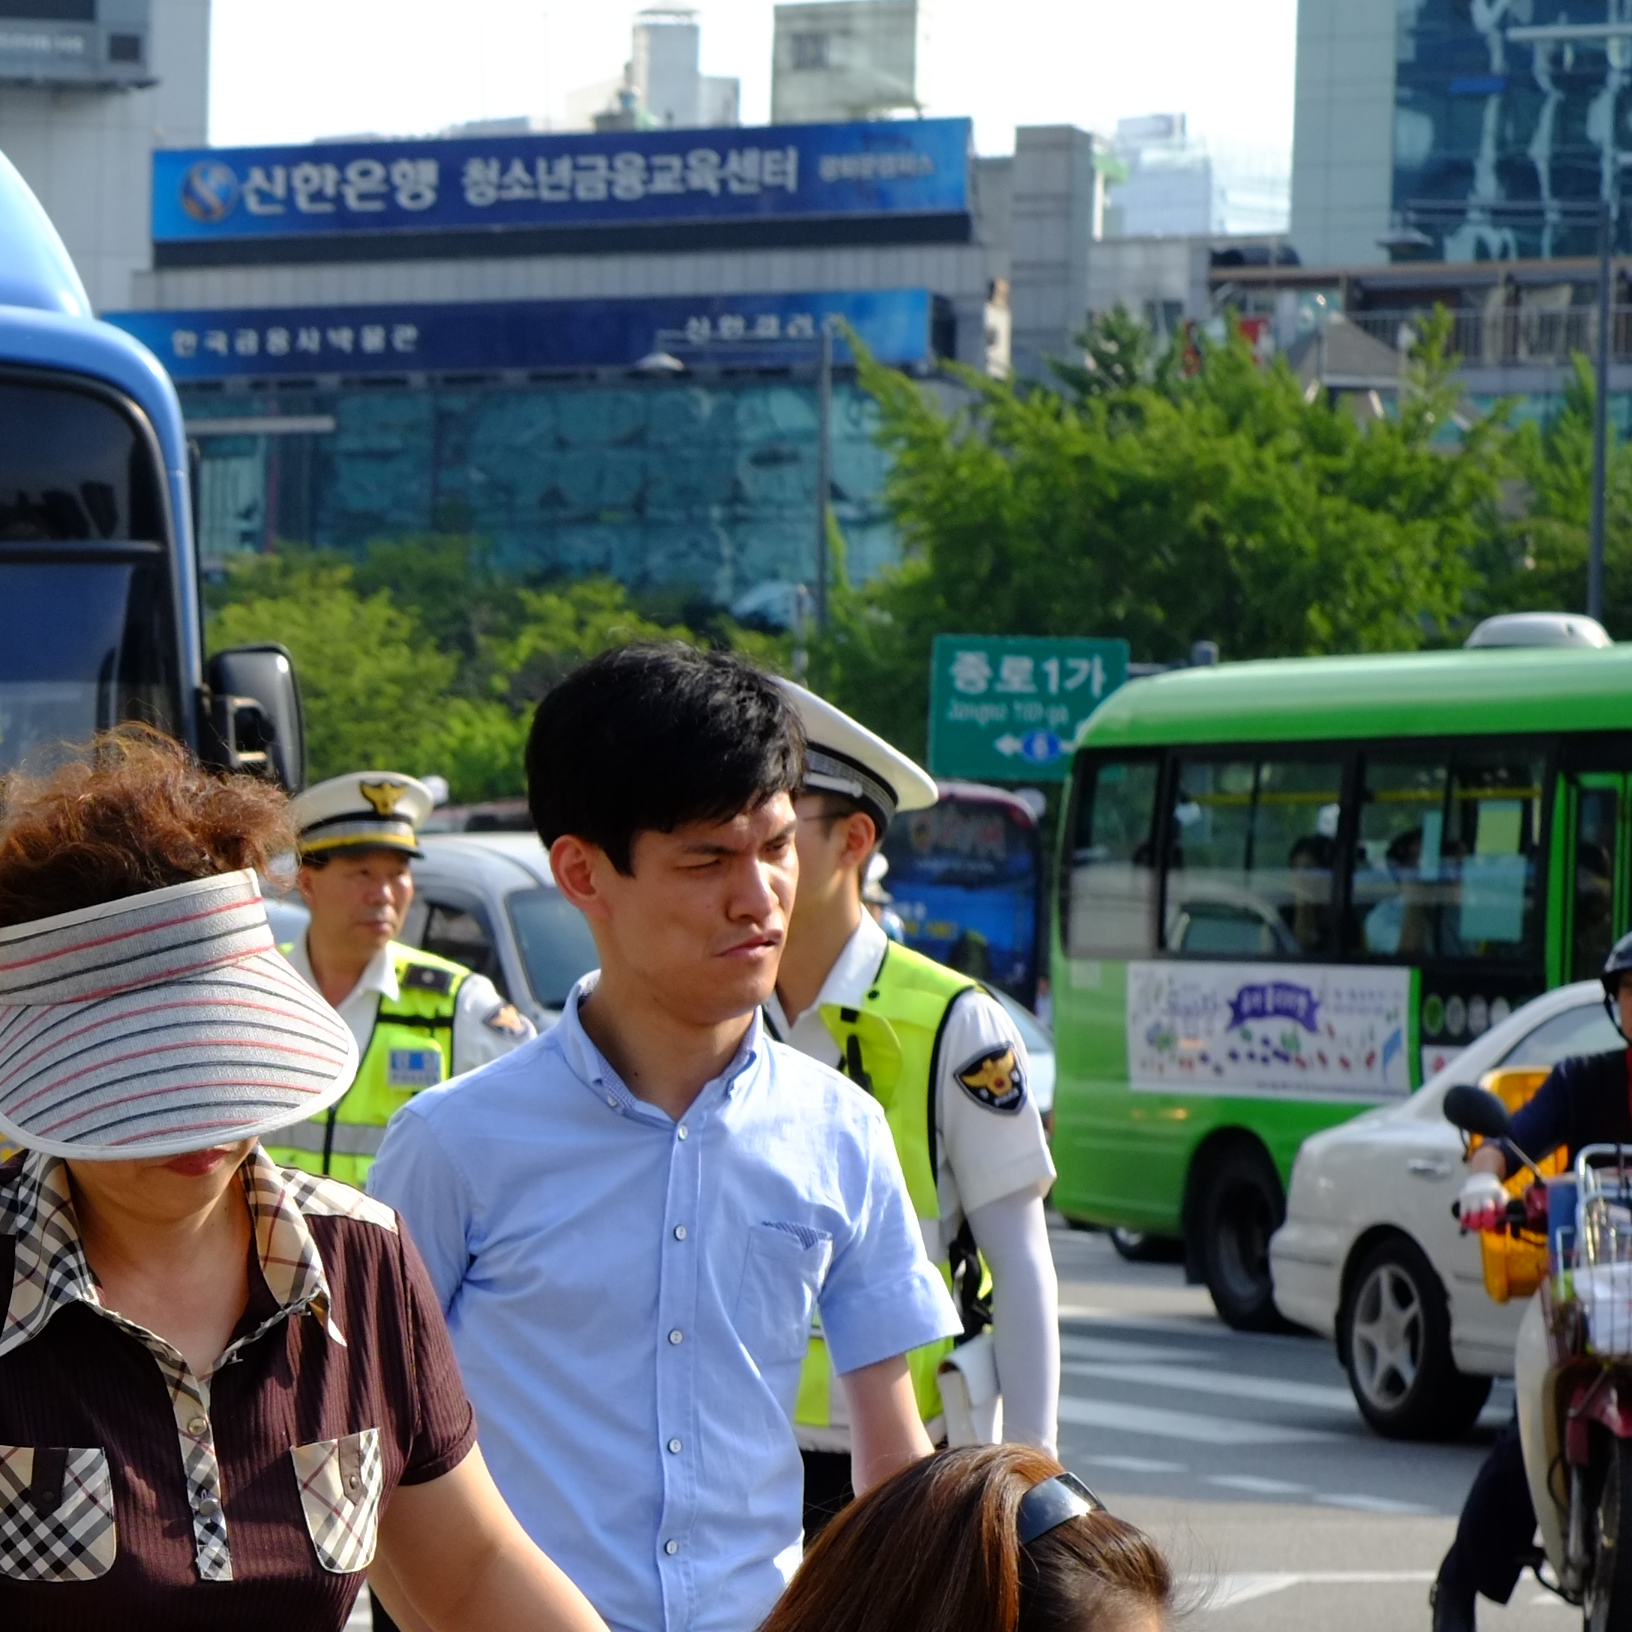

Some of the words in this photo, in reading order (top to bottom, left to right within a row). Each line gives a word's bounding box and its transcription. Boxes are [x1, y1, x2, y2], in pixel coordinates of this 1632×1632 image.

[241, 157, 440, 217] 신한은행
[461, 146, 800, 208] 청소년금융교육센터
[172, 324, 420, 358] 한국금융사박물관
[949, 650, 1107, 699] 종로1가
